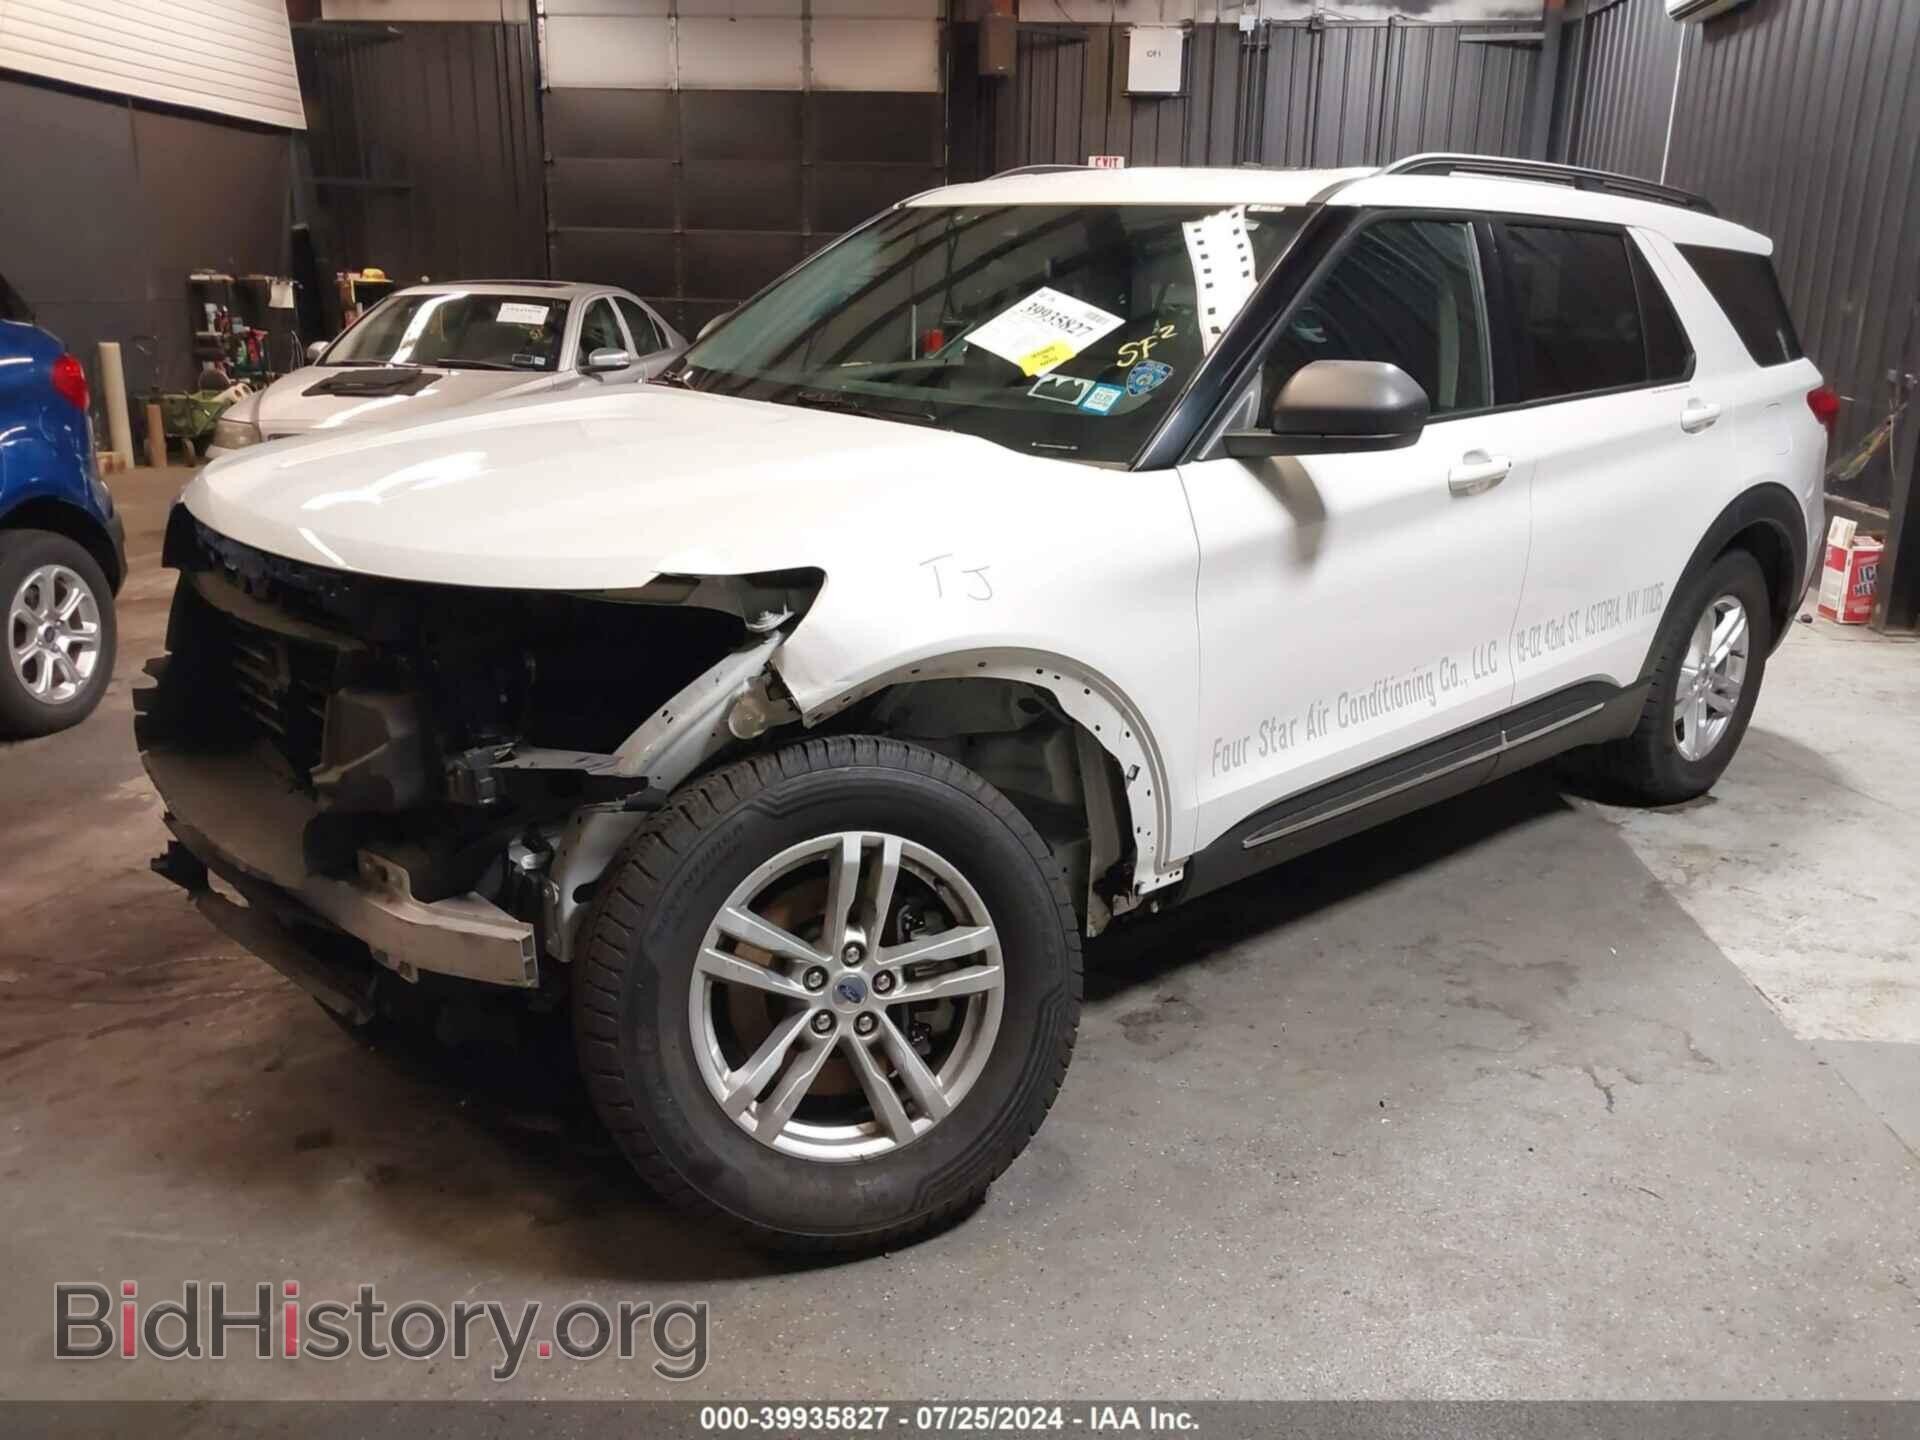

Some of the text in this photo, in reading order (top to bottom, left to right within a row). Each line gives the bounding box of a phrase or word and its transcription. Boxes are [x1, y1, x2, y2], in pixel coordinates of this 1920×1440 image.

[1020, 301, 1094, 338] 39935827
[1212, 735, 1250, 777] Four
[1258, 716, 1297, 757] Star
[1307, 701, 1330, 741] Air
[1337, 667, 1436, 729] Conditioning
[1472, 640, 1498, 680] LLC
[1625, 590, 1640, 624] NY
